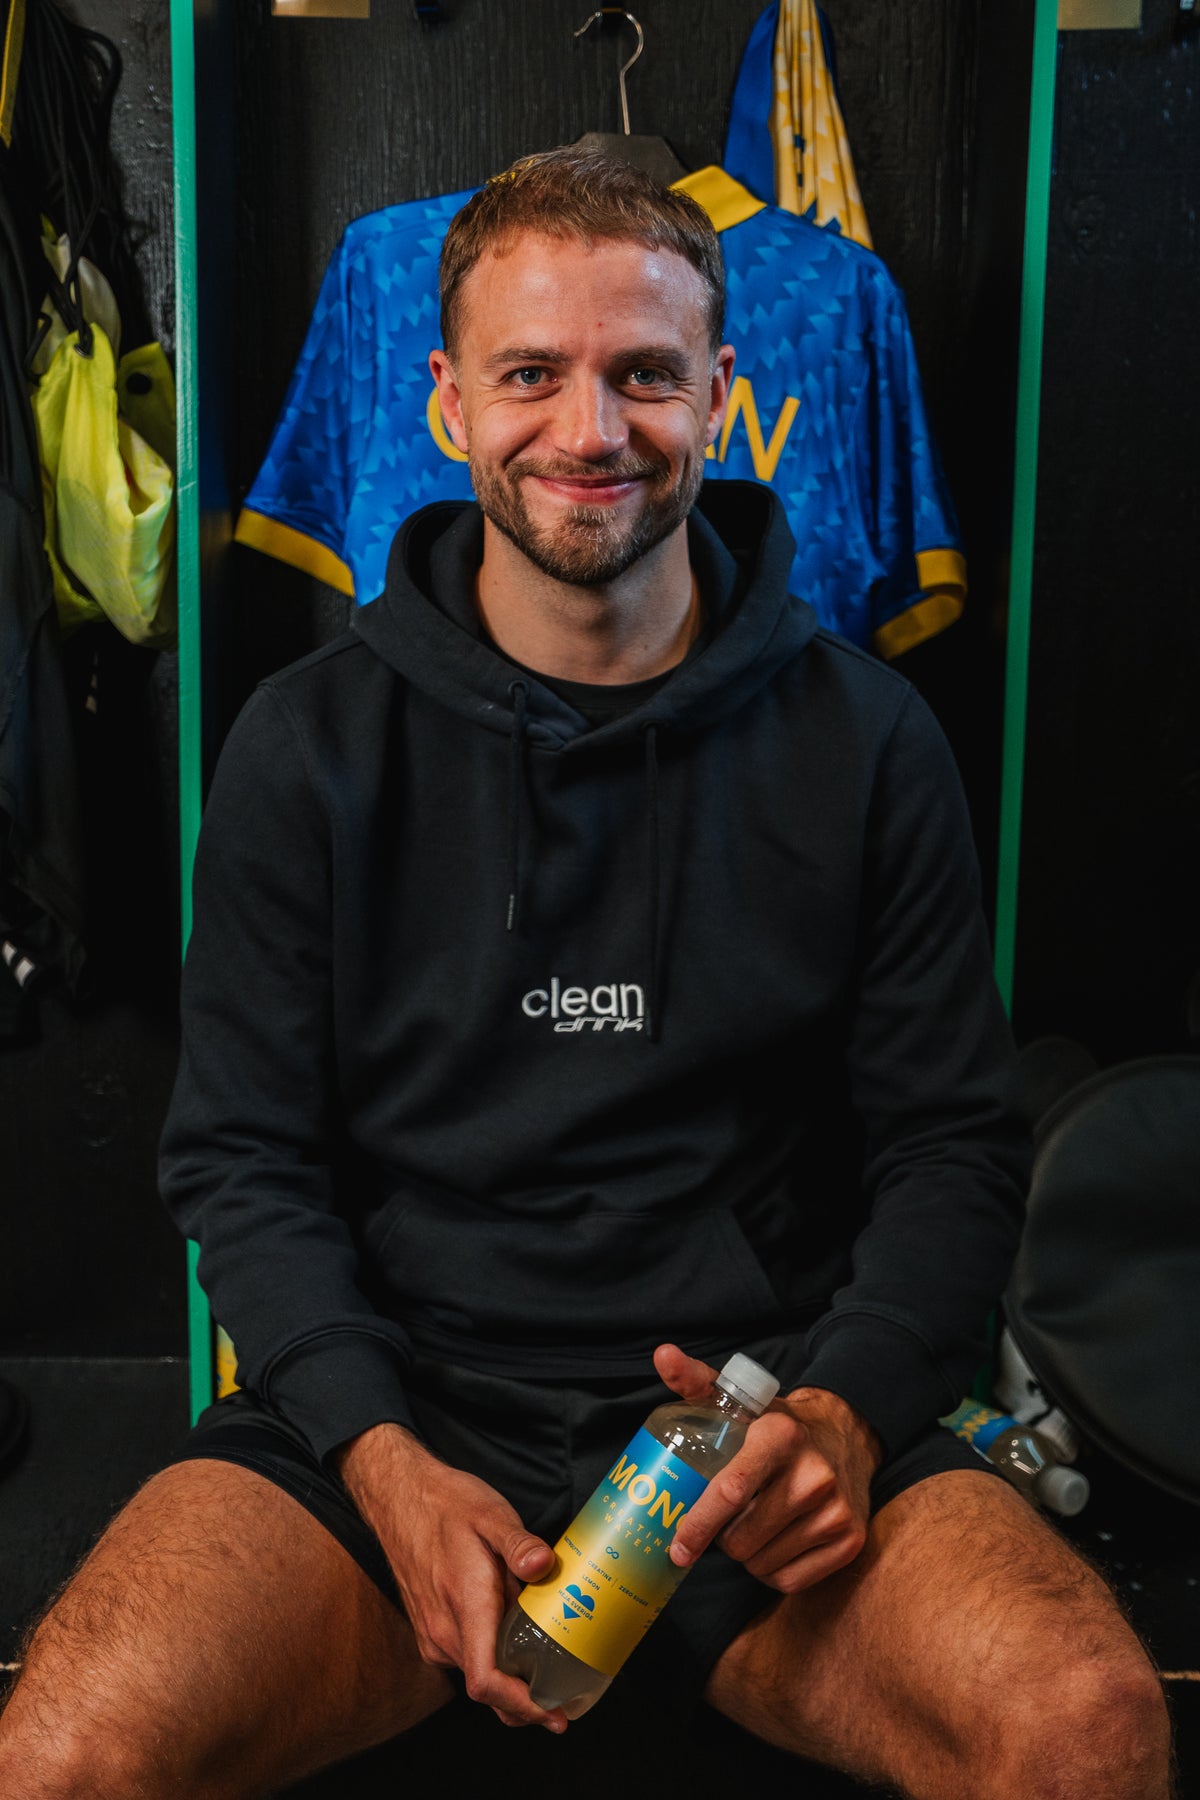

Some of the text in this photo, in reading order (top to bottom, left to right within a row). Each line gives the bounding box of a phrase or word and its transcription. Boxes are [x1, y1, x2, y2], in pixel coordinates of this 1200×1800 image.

[521, 976, 645, 1018] clean
[553, 1016, 644, 1033] drink
[660, 1465, 680, 1481] clean
[604, 1512, 652, 1554] WATER
[587, 1560, 612, 1582] CREATINE
[582, 1574, 601, 1591] LEMON
